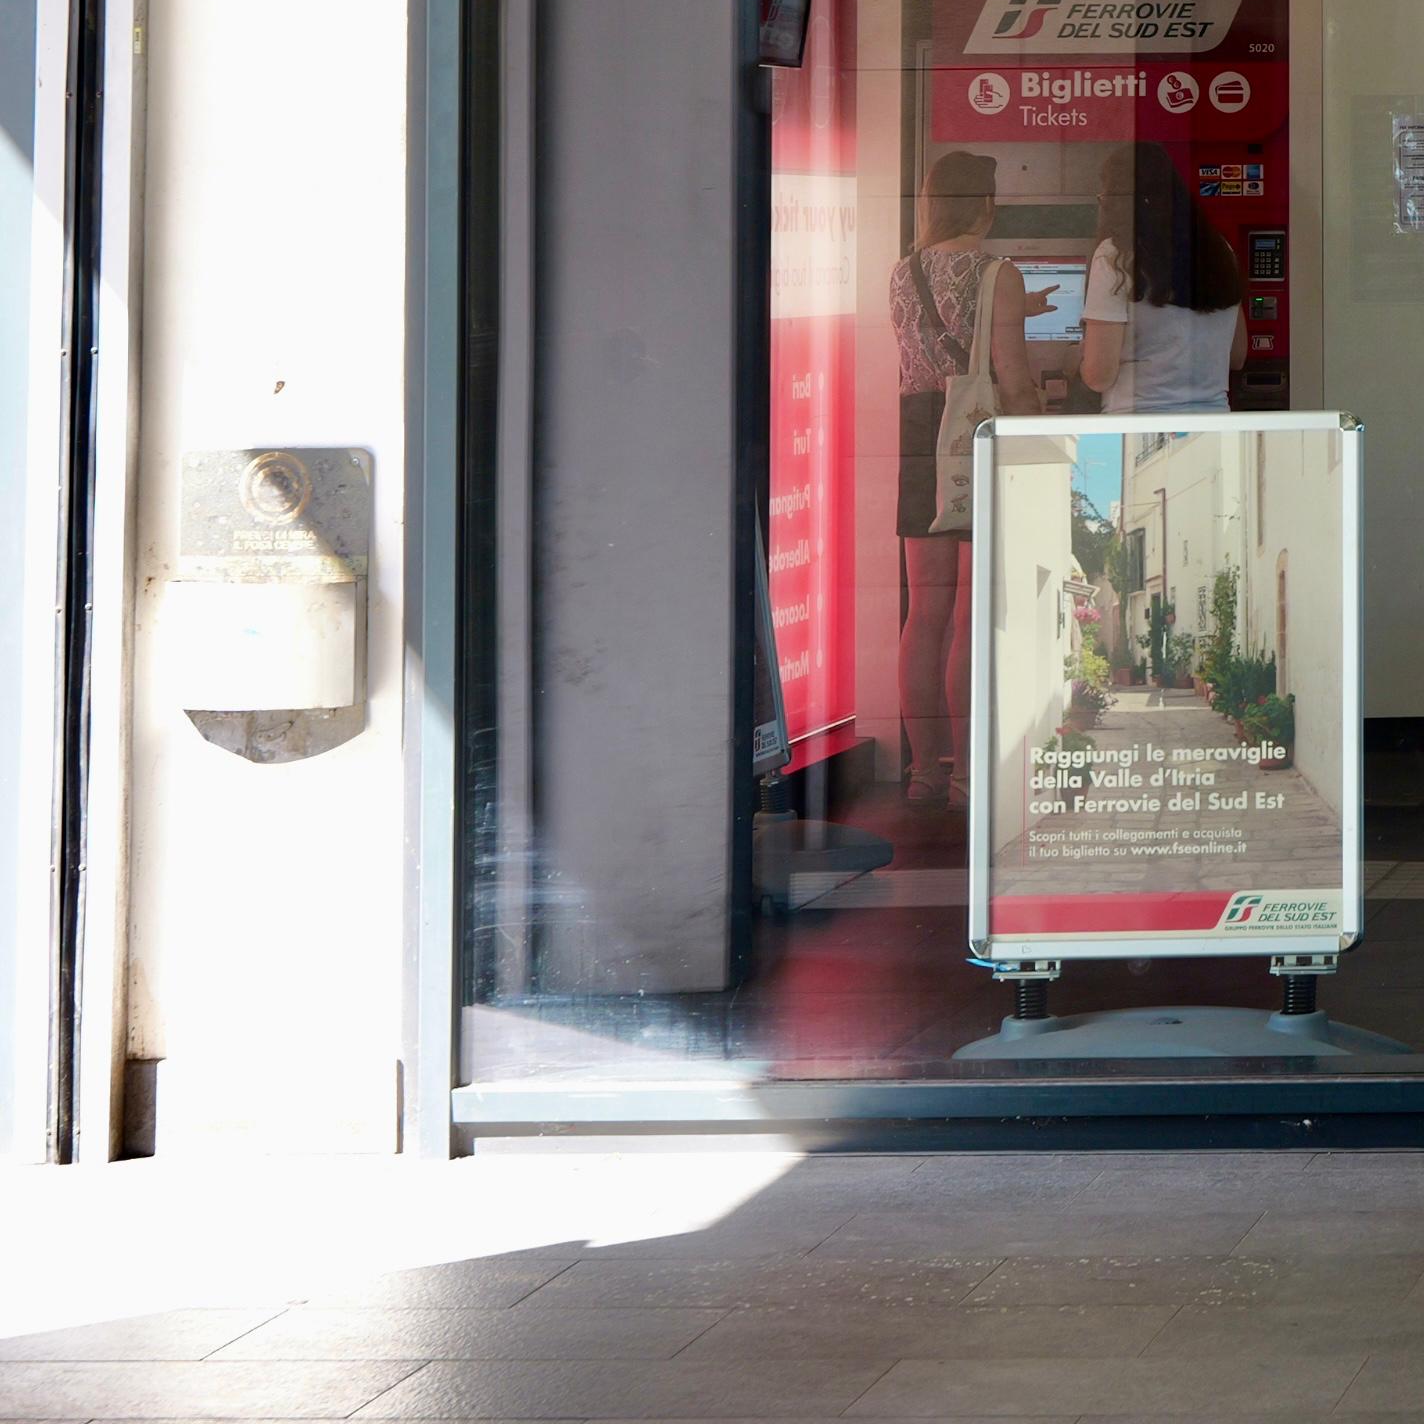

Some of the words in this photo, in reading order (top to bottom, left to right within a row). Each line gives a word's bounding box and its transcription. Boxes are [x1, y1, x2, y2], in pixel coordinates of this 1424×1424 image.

[1066, 2, 1196, 19] FERROVIE
[1057, 23, 1103, 40] DEL
[1108, 22, 1160, 39] SUD
[1163, 21, 1215, 39] EST
[1248, 43, 1276, 54] 5020
[1020, 71, 1147, 104] Biglietti
[1019, 105, 1089, 128] Tickets
[1030, 743, 1138, 769] Raggiungi
[1147, 743, 1165, 762] le
[1172, 741, 1286, 767] meraviglie
[1029, 770, 1082, 789] della
[1090, 769, 1143, 788] Valle
[1149, 767, 1215, 786] d'Itria
[1029, 799, 1066, 814] con
[1073, 795, 1160, 813] Ferrovie
[1168, 793, 1200, 811] del
[1208, 792, 1247, 810] Sud
[1255, 791, 1284, 809] Est
[1029, 830, 1066, 845] Scopri
[1069, 829, 1093, 841] tutti
[1096, 829, 1099, 841] i
[1103, 827, 1178, 844] collegamenti
[1182, 830, 1190, 839] e
[1193, 828, 1242, 842] acquista
[1029, 845, 1037, 857] il
[1040, 846, 1059, 857] tuo
[1062, 845, 1110, 860] biglietto
[1113, 847, 1127, 856] su
[1131, 842, 1247, 855] www.fseonline.it
[1262, 902, 1328, 912] FERROVIE
[1258, 913, 1281, 922] DEL
[1284, 913, 1309, 922] SUD
[1311, 912, 1337, 921] EST
